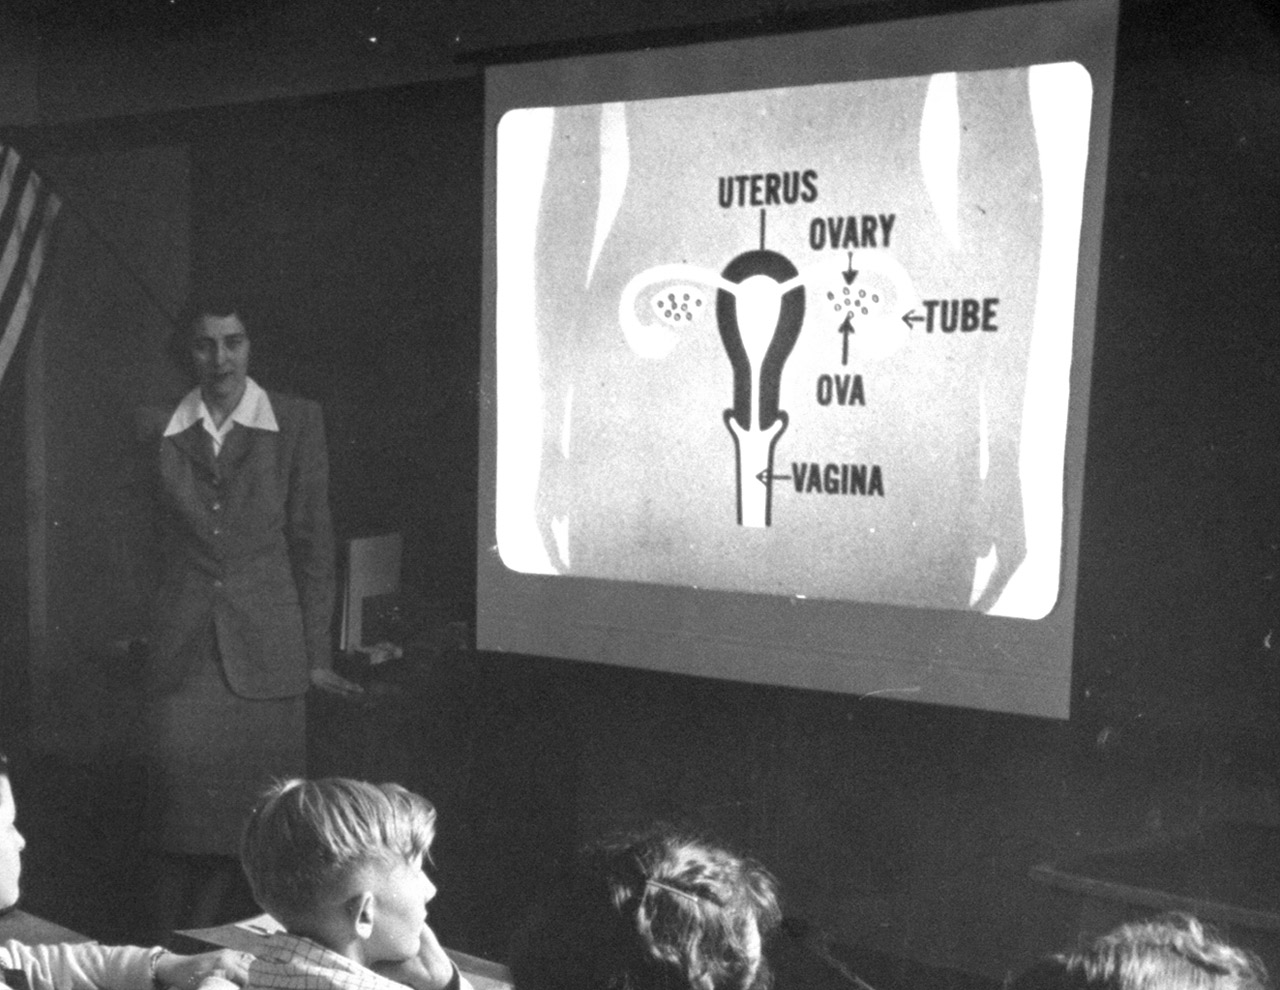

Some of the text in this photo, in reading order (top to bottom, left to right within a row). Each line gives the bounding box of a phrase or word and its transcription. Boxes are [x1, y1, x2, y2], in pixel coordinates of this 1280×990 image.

[718, 170, 819, 208] UTERUS
[809, 213, 896, 251] OVARY
[923, 298, 999, 333] TUBE
[816, 373, 866, 406] OVA
[791, 462, 885, 497] VAGINA
